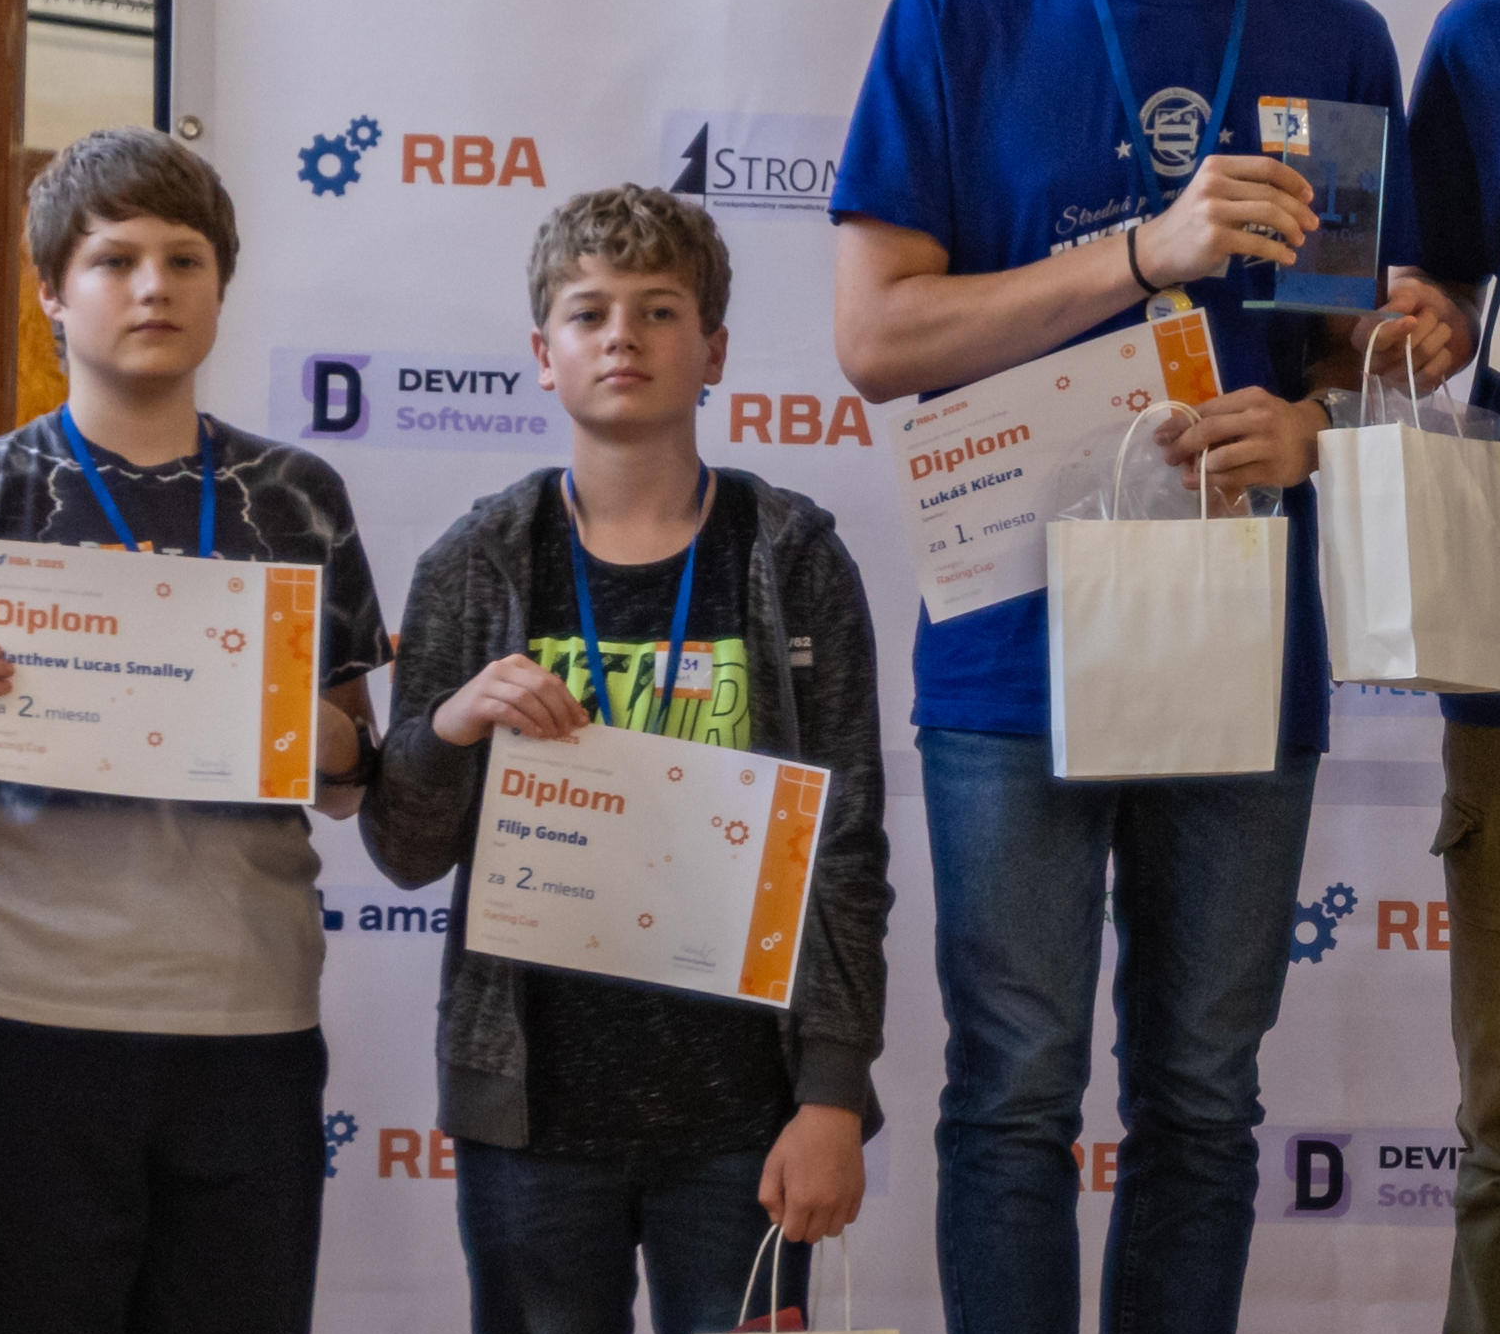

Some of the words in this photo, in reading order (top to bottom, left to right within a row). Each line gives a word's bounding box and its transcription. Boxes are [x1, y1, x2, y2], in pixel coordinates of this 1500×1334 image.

[402, 134, 546, 189] RBA
[398, 368, 521, 396] DEVITY
[395, 405, 548, 437] Software
[730, 393, 873, 447] RBA
[909, 424, 1030, 481] Diplom
[920, 482, 968, 510] Lukáš
[971, 467, 1023, 492] Kičura
[929, 540, 947, 553] za
[955, 524, 974, 545] 1.
[983, 511, 1036, 536] miesto
[74, 656, 121, 674] Lucas
[126, 661, 194, 683] Smalley
[18, 695, 41, 718] 2.
[45, 707, 101, 723] miesto
[500, 768, 626, 815] Diplom
[497, 819, 531, 840] Filip
[535, 826, 589, 847] Gonda
[487, 873, 506, 885] za
[516, 867, 538, 891] 2.
[541, 882, 596, 901] miesto
[1377, 900, 1451, 951] RB
[379, 1129, 456, 1179] RB
